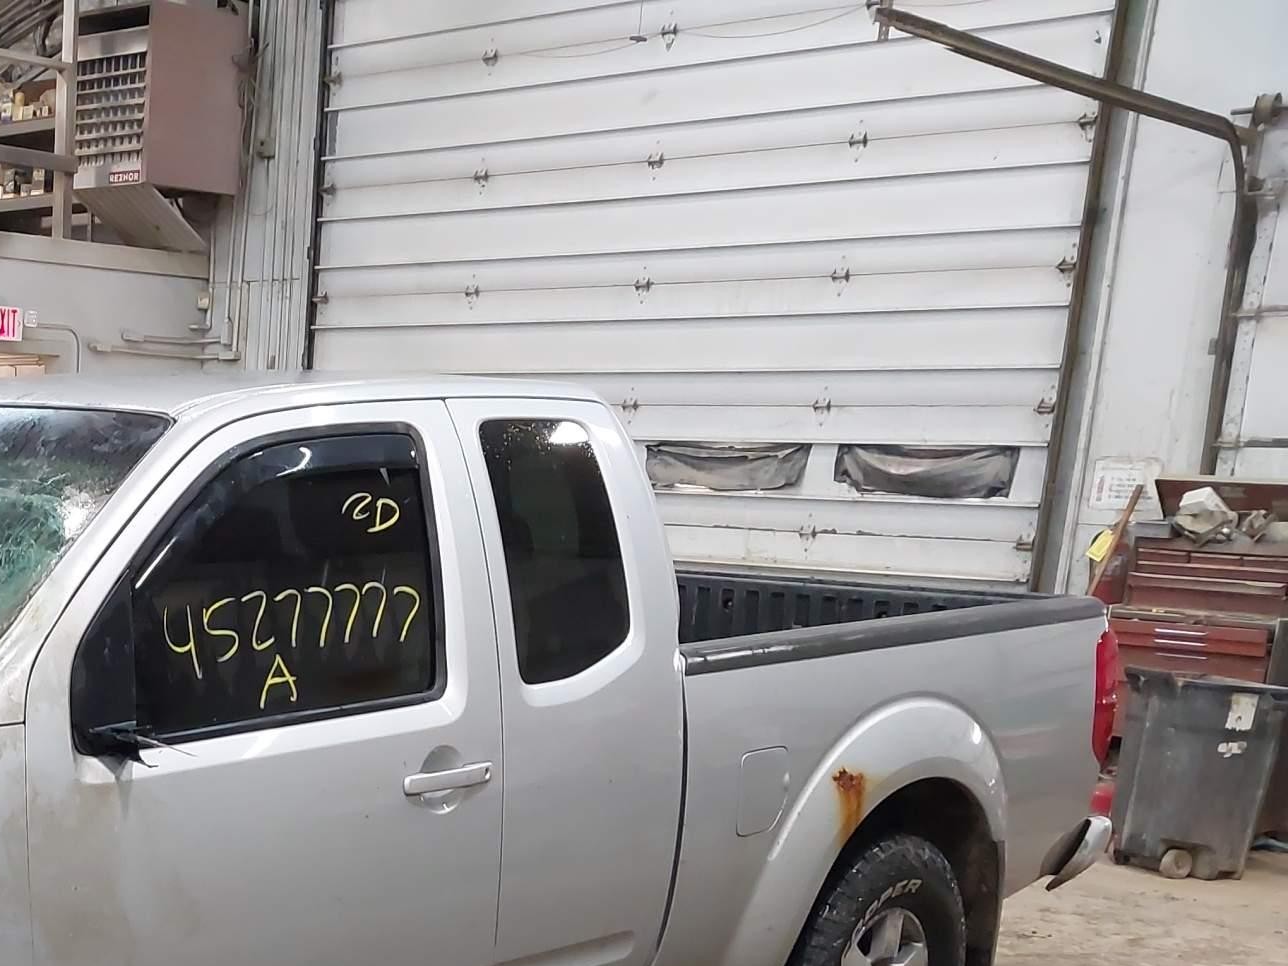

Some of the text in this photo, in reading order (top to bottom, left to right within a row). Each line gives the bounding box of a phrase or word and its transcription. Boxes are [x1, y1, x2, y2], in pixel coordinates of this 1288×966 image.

[109, 172, 139, 182] REZNOR
[163, 581, 420, 680] 45277777
[259, 653, 298, 709] A
